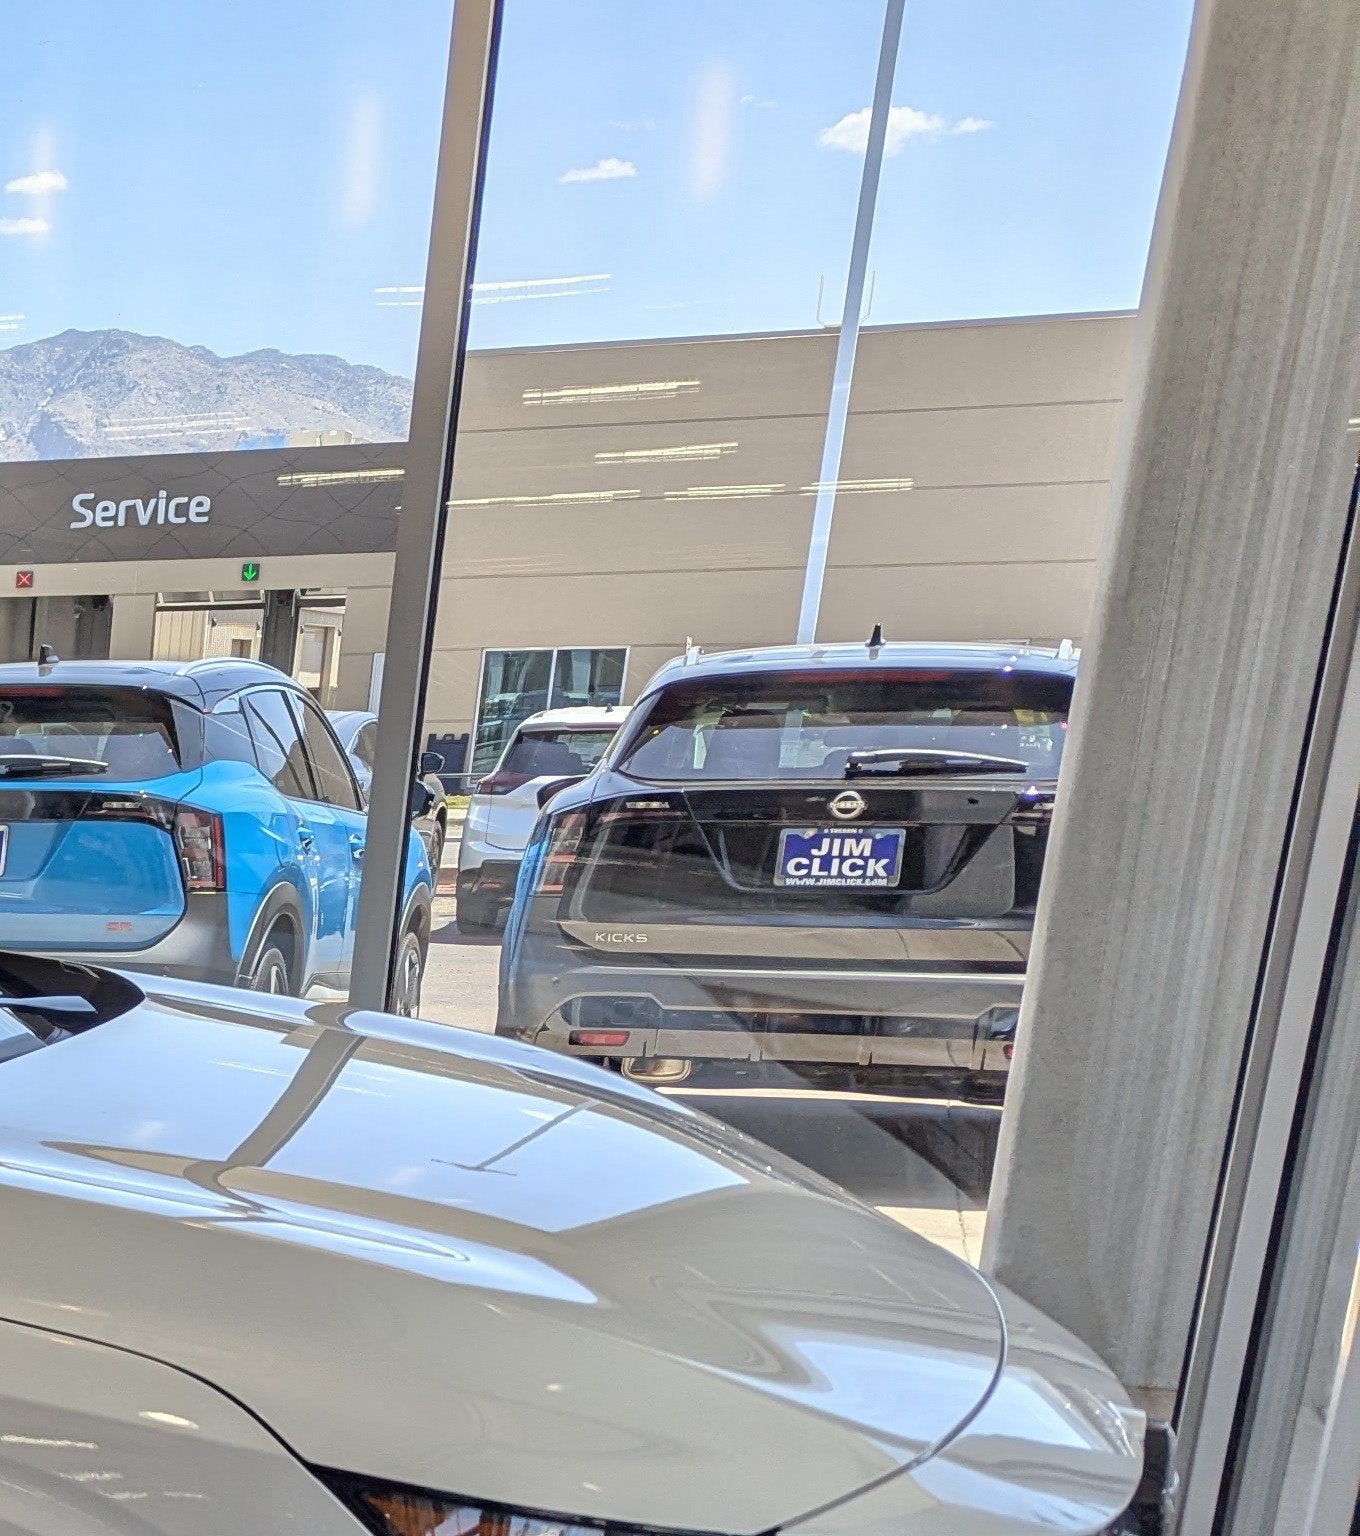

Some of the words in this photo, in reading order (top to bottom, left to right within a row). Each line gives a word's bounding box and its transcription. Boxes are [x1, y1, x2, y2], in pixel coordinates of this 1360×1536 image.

[70, 489, 211, 529] Service
[810, 837, 873, 857] JIM
[786, 857, 890, 877] CLICK
[595, 932, 648, 943] KICKS
